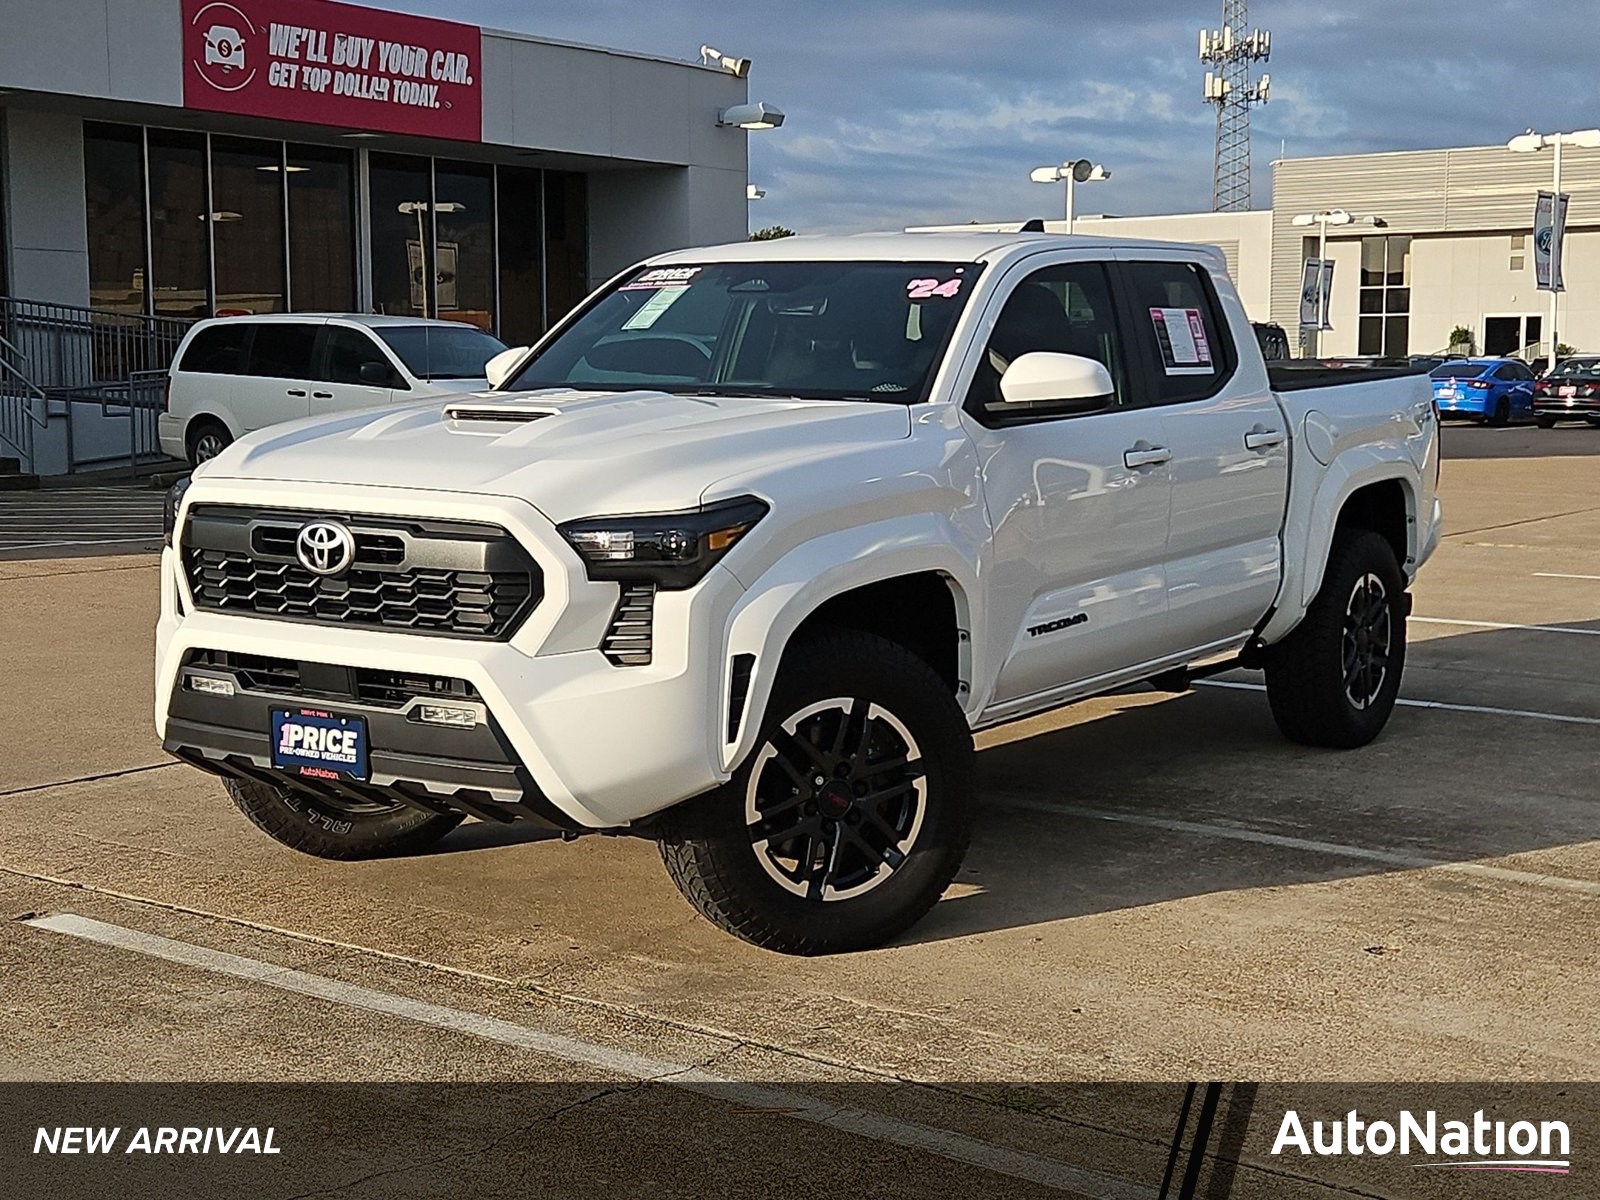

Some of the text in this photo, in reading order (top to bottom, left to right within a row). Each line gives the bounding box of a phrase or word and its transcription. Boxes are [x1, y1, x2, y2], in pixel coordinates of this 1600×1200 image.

[269, 23, 473, 86] WE'LL BUY YOUR CAR.
[268, 61, 440, 109] GET TOP DOLLAR TODAY.
[1026, 612, 1089, 637] TACOMA
[279, 745, 357, 763] PRE-OWNED VEHICLES
[280, 723, 358, 756] 1PRICE
[299, 766, 340, 780] AutoNation
